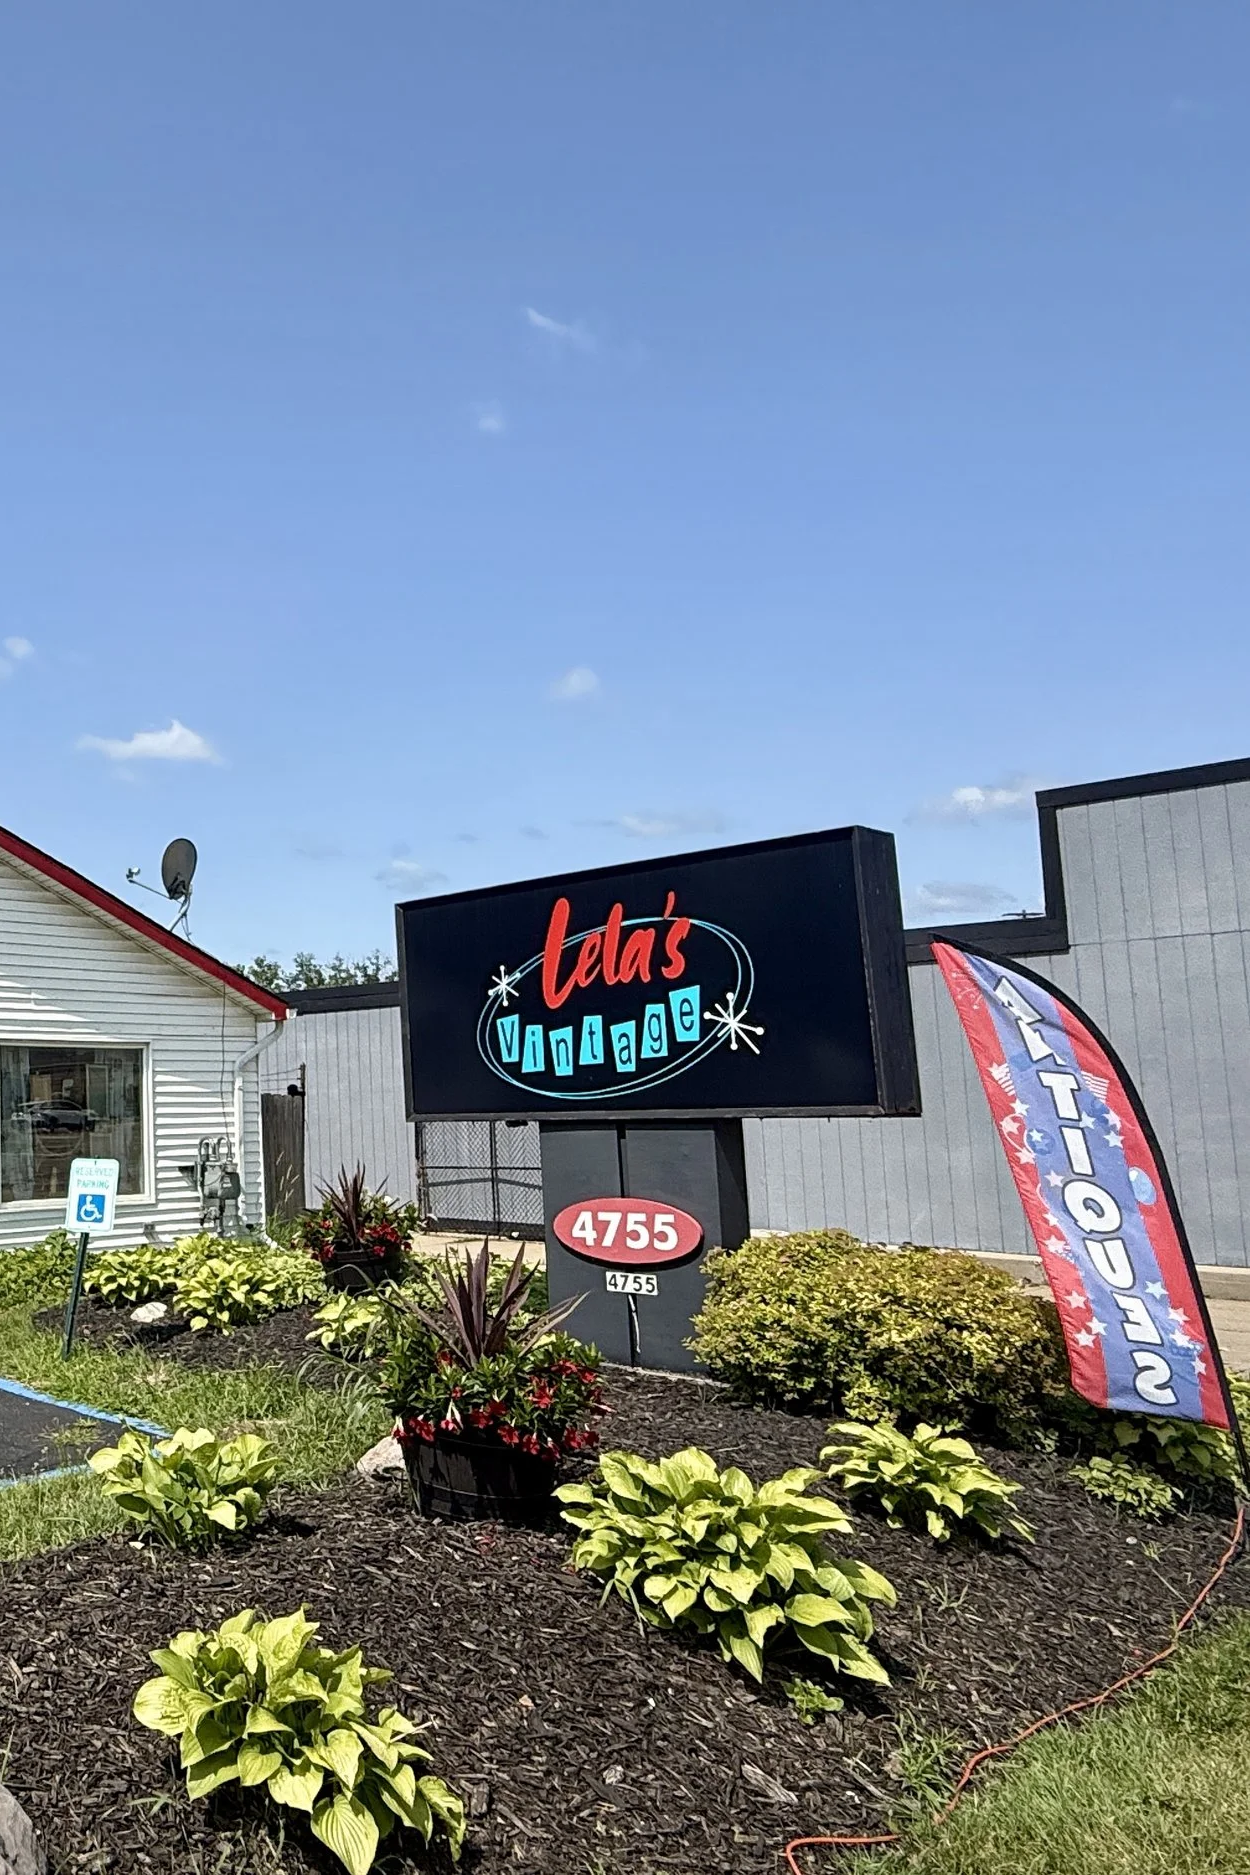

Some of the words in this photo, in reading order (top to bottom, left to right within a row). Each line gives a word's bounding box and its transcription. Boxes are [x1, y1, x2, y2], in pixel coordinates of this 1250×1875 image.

[542, 891, 691, 1009] Lela's
[498, 989, 699, 1073] Vintage
[75, 1167, 114, 1176] RESERVED
[77, 1178, 109, 1189] PARKING
[571, 1211, 678, 1250] 4755
[608, 1274, 656, 1293] 4755
